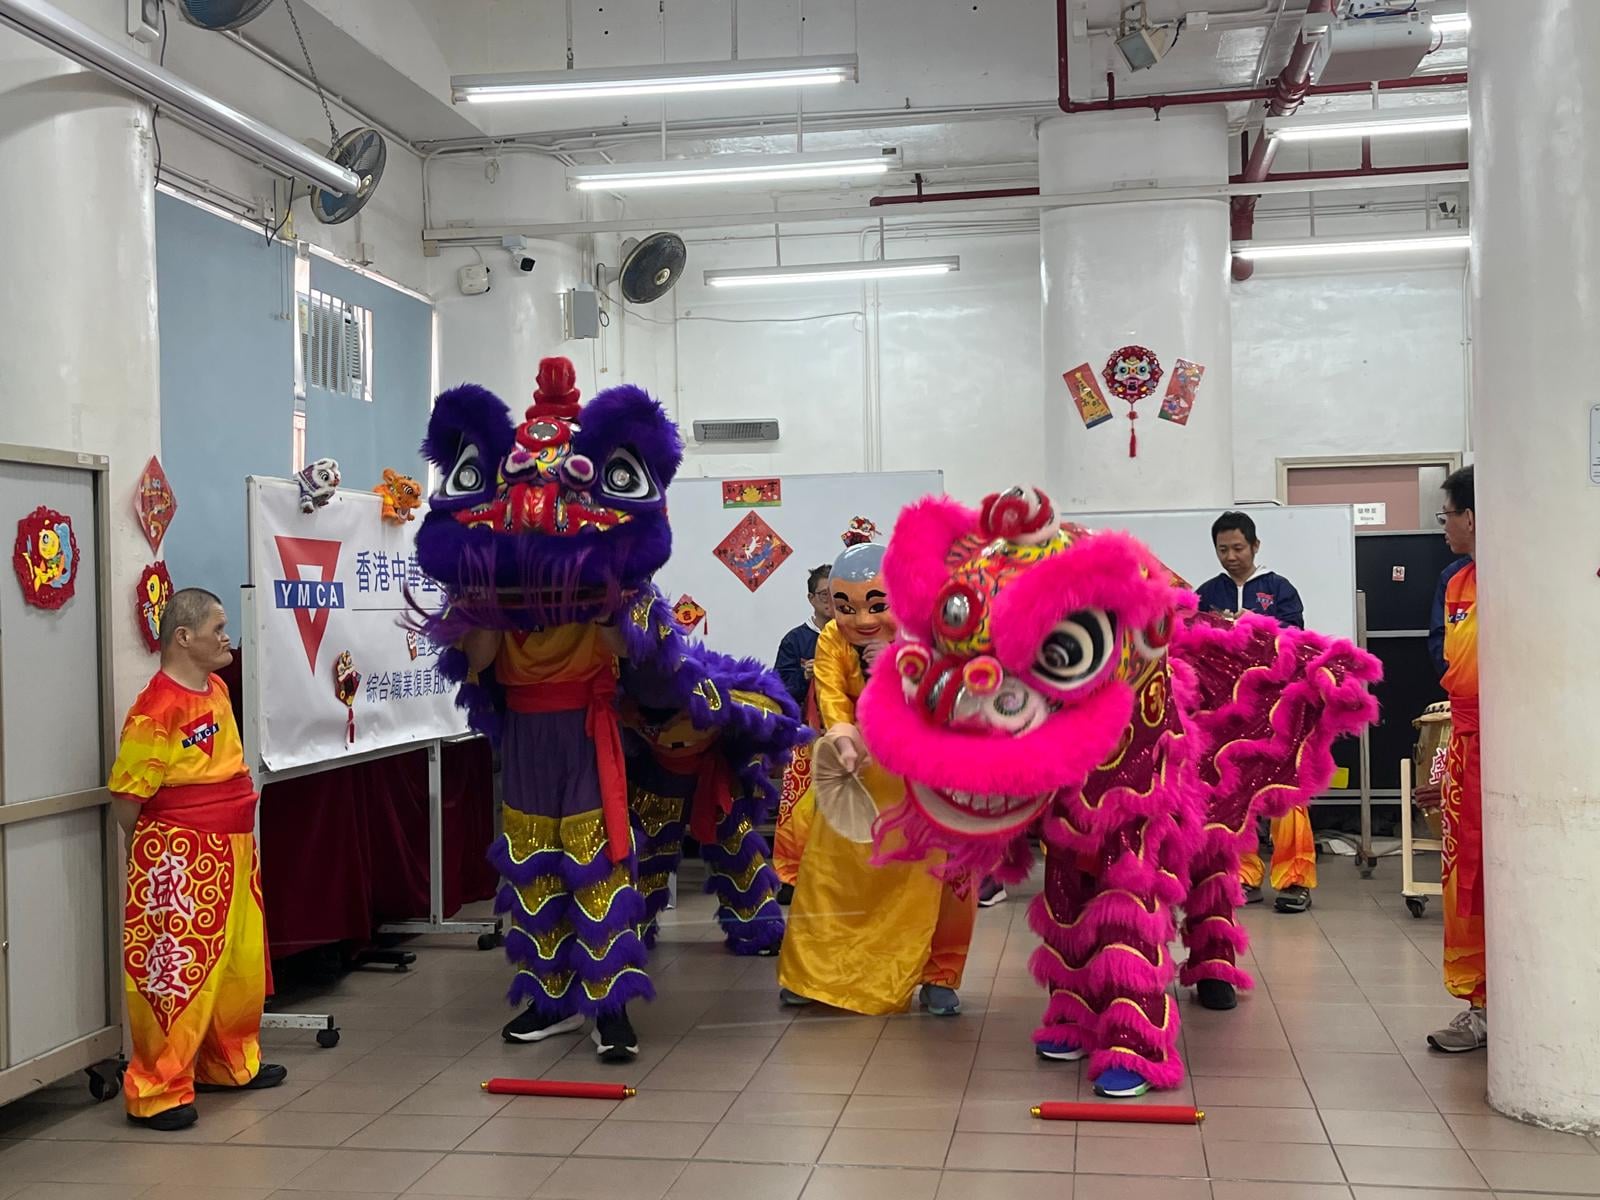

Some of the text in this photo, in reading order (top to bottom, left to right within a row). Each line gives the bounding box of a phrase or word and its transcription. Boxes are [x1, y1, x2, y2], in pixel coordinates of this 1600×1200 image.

[281, 583, 339, 607] YMCA
[366, 667, 452, 703] 綜合職業復康服
[186, 725, 217, 745] YMCA
